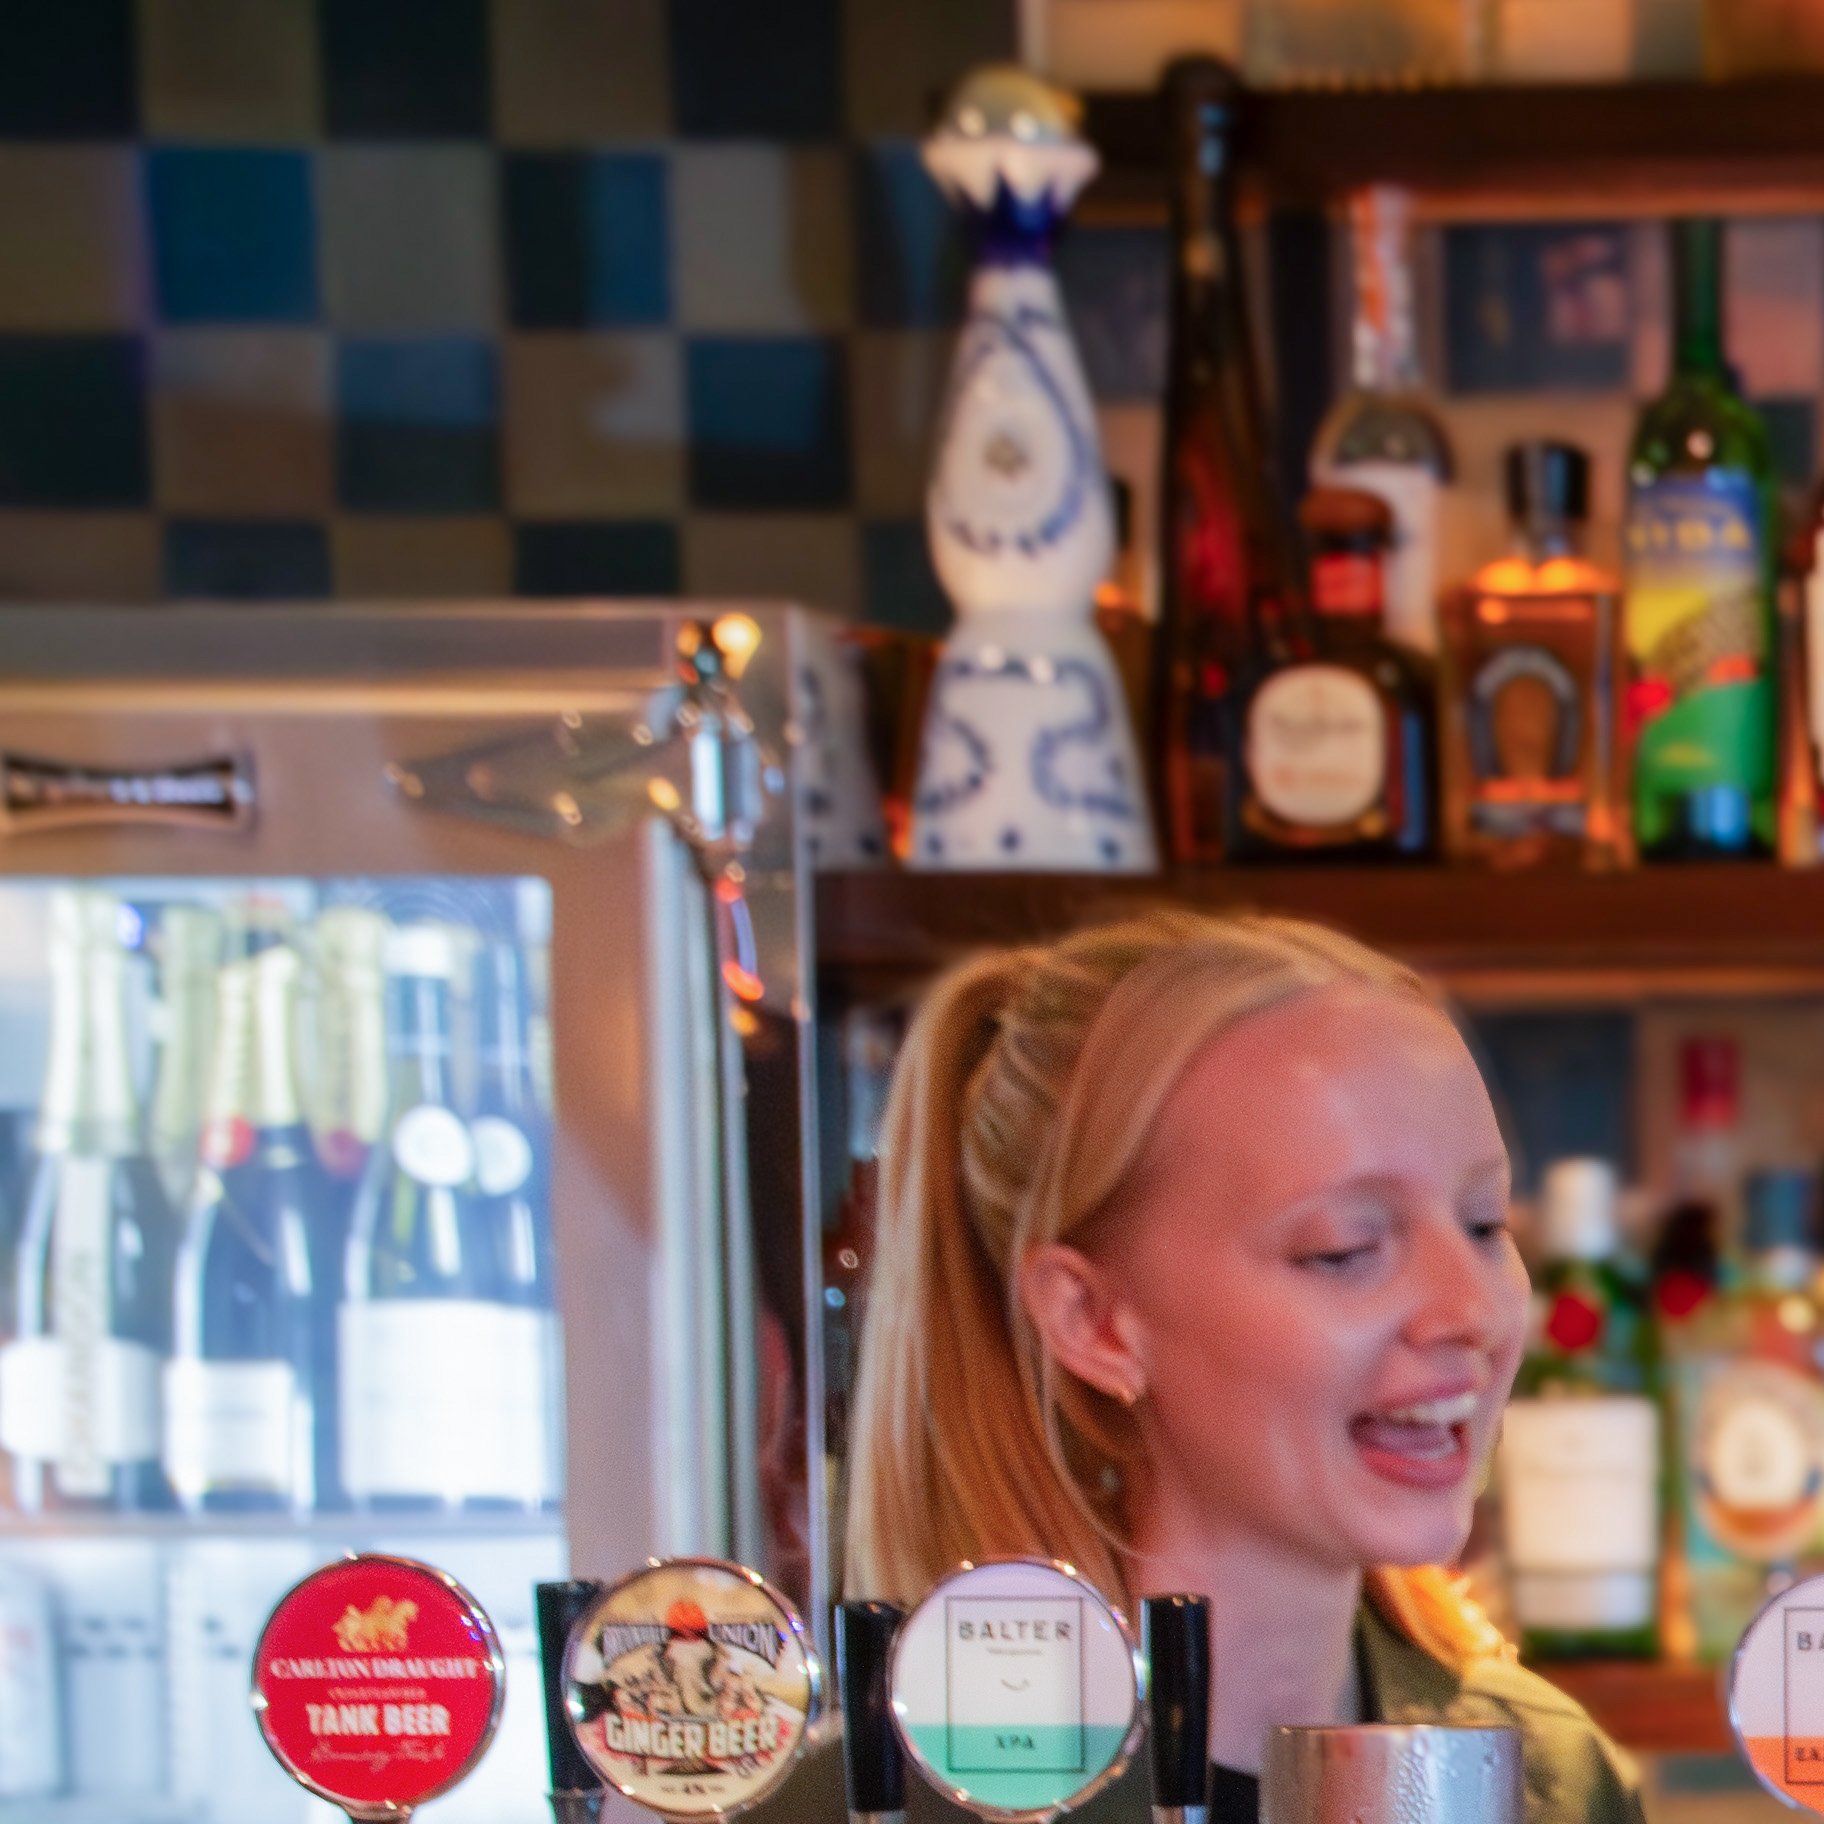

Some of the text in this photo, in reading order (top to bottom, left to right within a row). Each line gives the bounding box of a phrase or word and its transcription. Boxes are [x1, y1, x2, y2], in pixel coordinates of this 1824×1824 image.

[957, 1619, 1071, 1642] BALTER
[305, 1703, 451, 1736] TANK BEER
[603, 1713, 783, 1758] GINGER BEER
